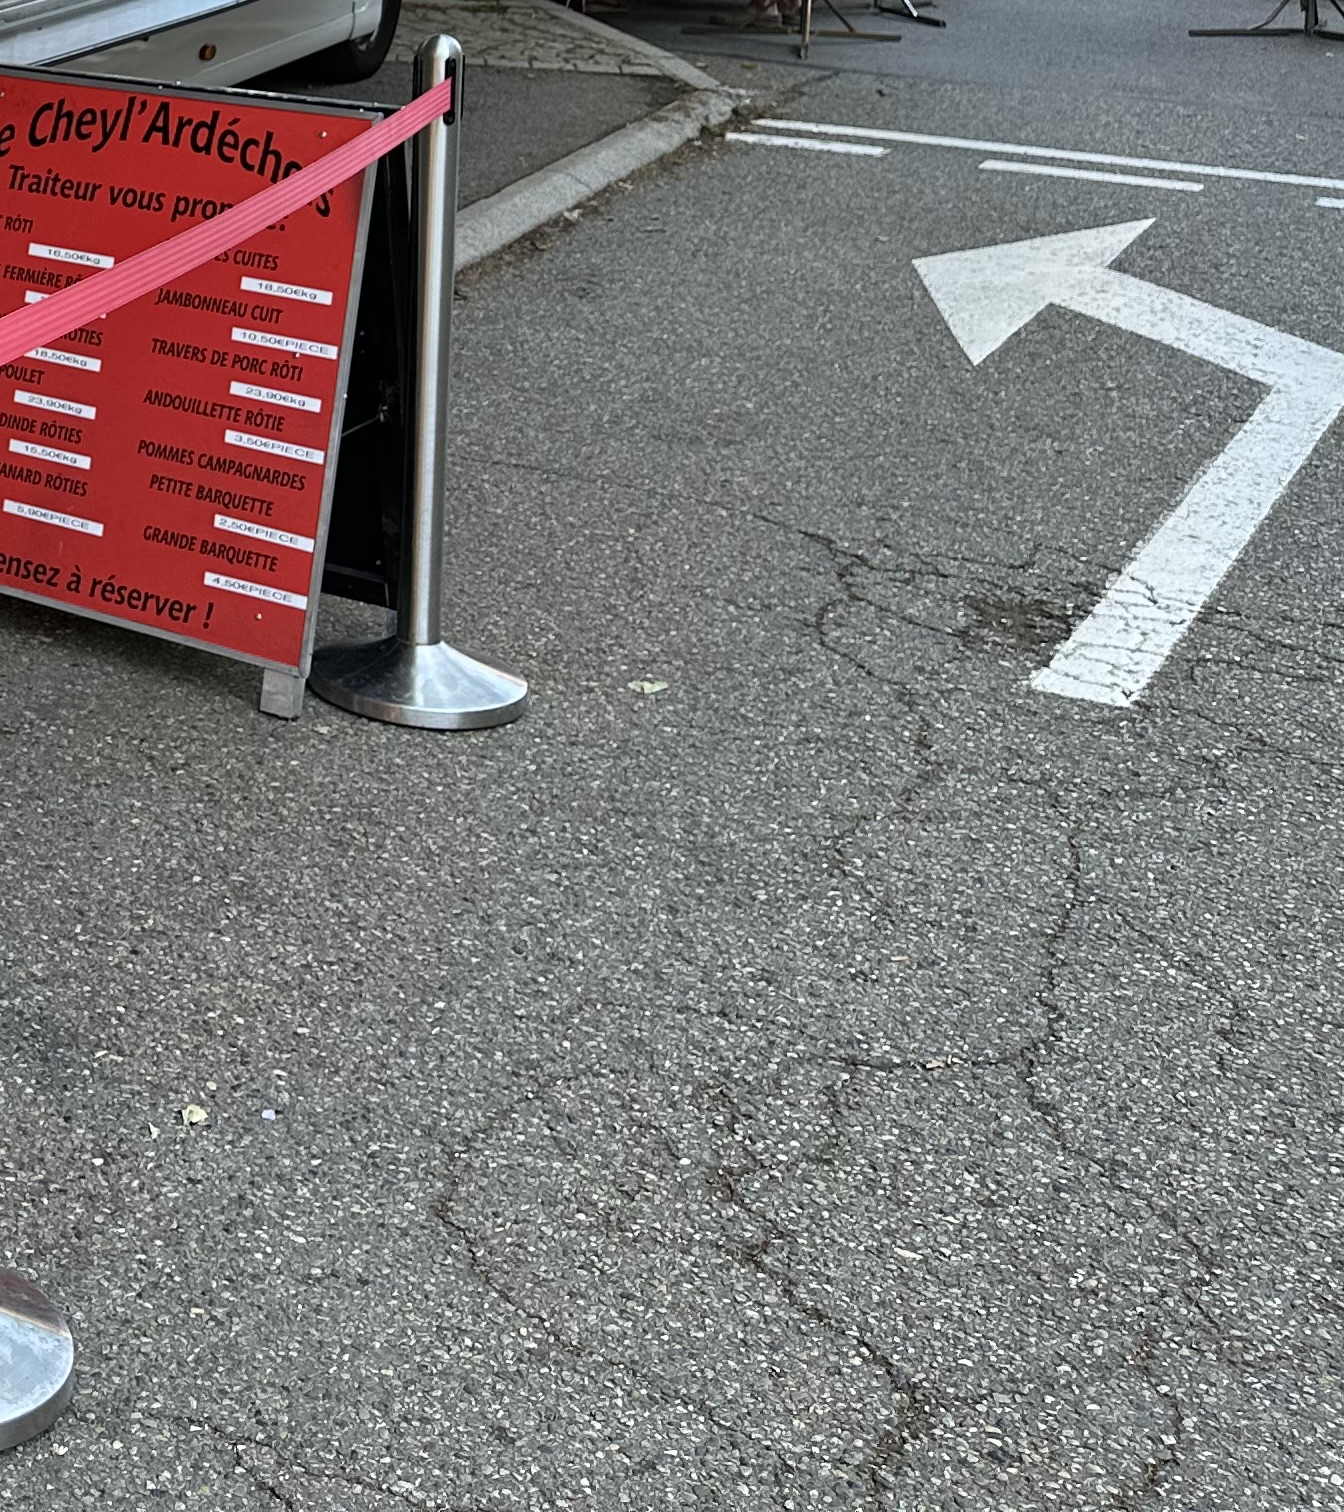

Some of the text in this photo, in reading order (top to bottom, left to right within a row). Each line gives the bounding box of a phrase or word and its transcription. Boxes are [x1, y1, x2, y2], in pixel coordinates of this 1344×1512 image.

[8, 164, 167, 212] Traiteur vous
[4, 214, 34, 234] RÔTI
[3, 267, 62, 290] FERMIÈRE
[233, 250, 279, 271] CUITES
[154, 288, 284, 324] JAMBONNEAU CUIT
[152, 338, 303, 382] TRAVERS DE PORC RÔTI
[143, 389, 285, 432] ANDOUILLETTE RÔTIE
[39, 420, 83, 445] RÔTIES
[44, 470, 89, 497] RÔTIES
[137, 440, 307, 491] POMMES CAMPAGNARDES
[149, 474, 274, 517] PETITE BARQUETTE
[143, 525, 278, 573] GRANDE BARQUETTE
[66, 564, 82, 594] à
[88, 574, 197, 624] réserver
[202, 602, 215, 629] !
